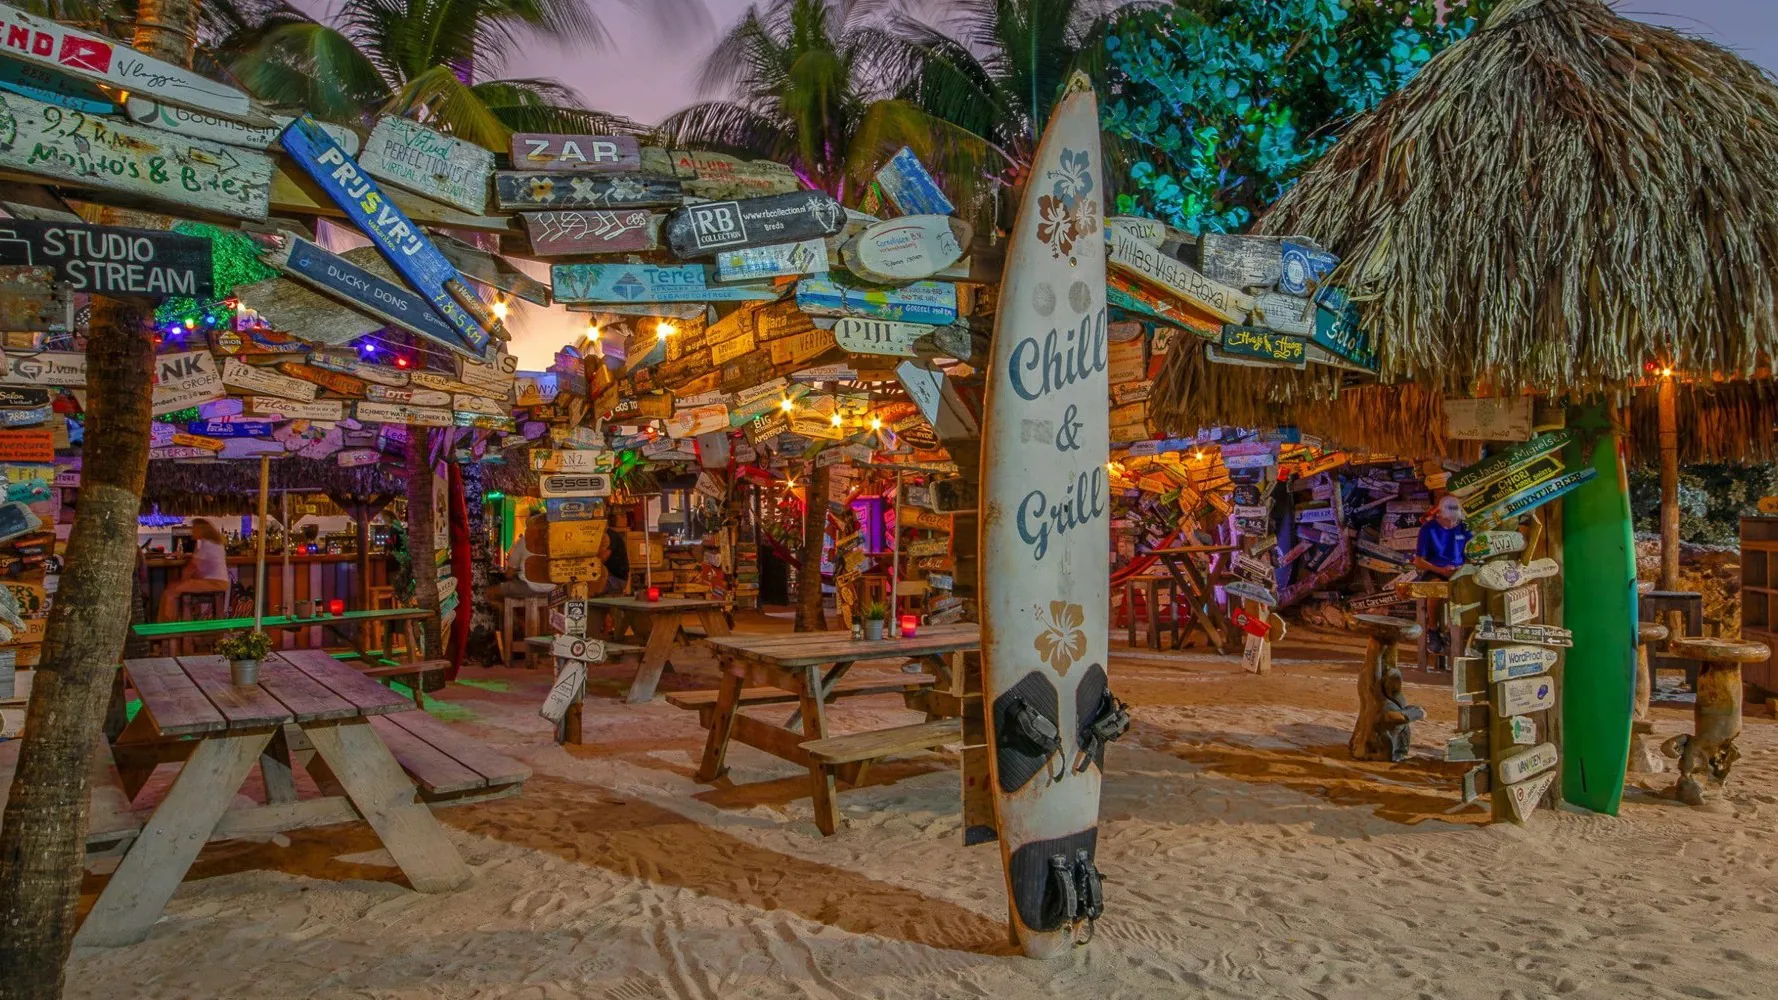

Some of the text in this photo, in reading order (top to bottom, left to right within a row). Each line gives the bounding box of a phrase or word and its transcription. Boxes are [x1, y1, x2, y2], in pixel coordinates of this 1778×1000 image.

[0, 21, 54, 57] ND
[383, 140, 473, 185] PERFECTIONIST
[525, 139, 619, 162] ZAR
[150, 156, 170, 184] &
[695, 207, 735, 235] RB
[743, 205, 807, 221] www.rbcollection.nl
[764, 221, 785, 232] Breda
[43, 228, 154, 262] STUDIO
[701, 231, 742, 243] COLLECTION
[66, 260, 196, 295] STREAM
[327, 264, 408, 311] DUCKY DONS
[1118, 235, 1230, 312] Villas Vista Royal
[1009, 307, 1108, 401] Chill
[182, 374, 218, 390] GROEP
[387, 391, 411, 400] DTC
[754, 415, 771, 429] BIG
[754, 425, 788, 444] AMSTERDAM
[1056, 404, 1083, 452] &
[1016, 466, 1104, 561] Grill
[1508, 650, 1543, 664] WordProof
